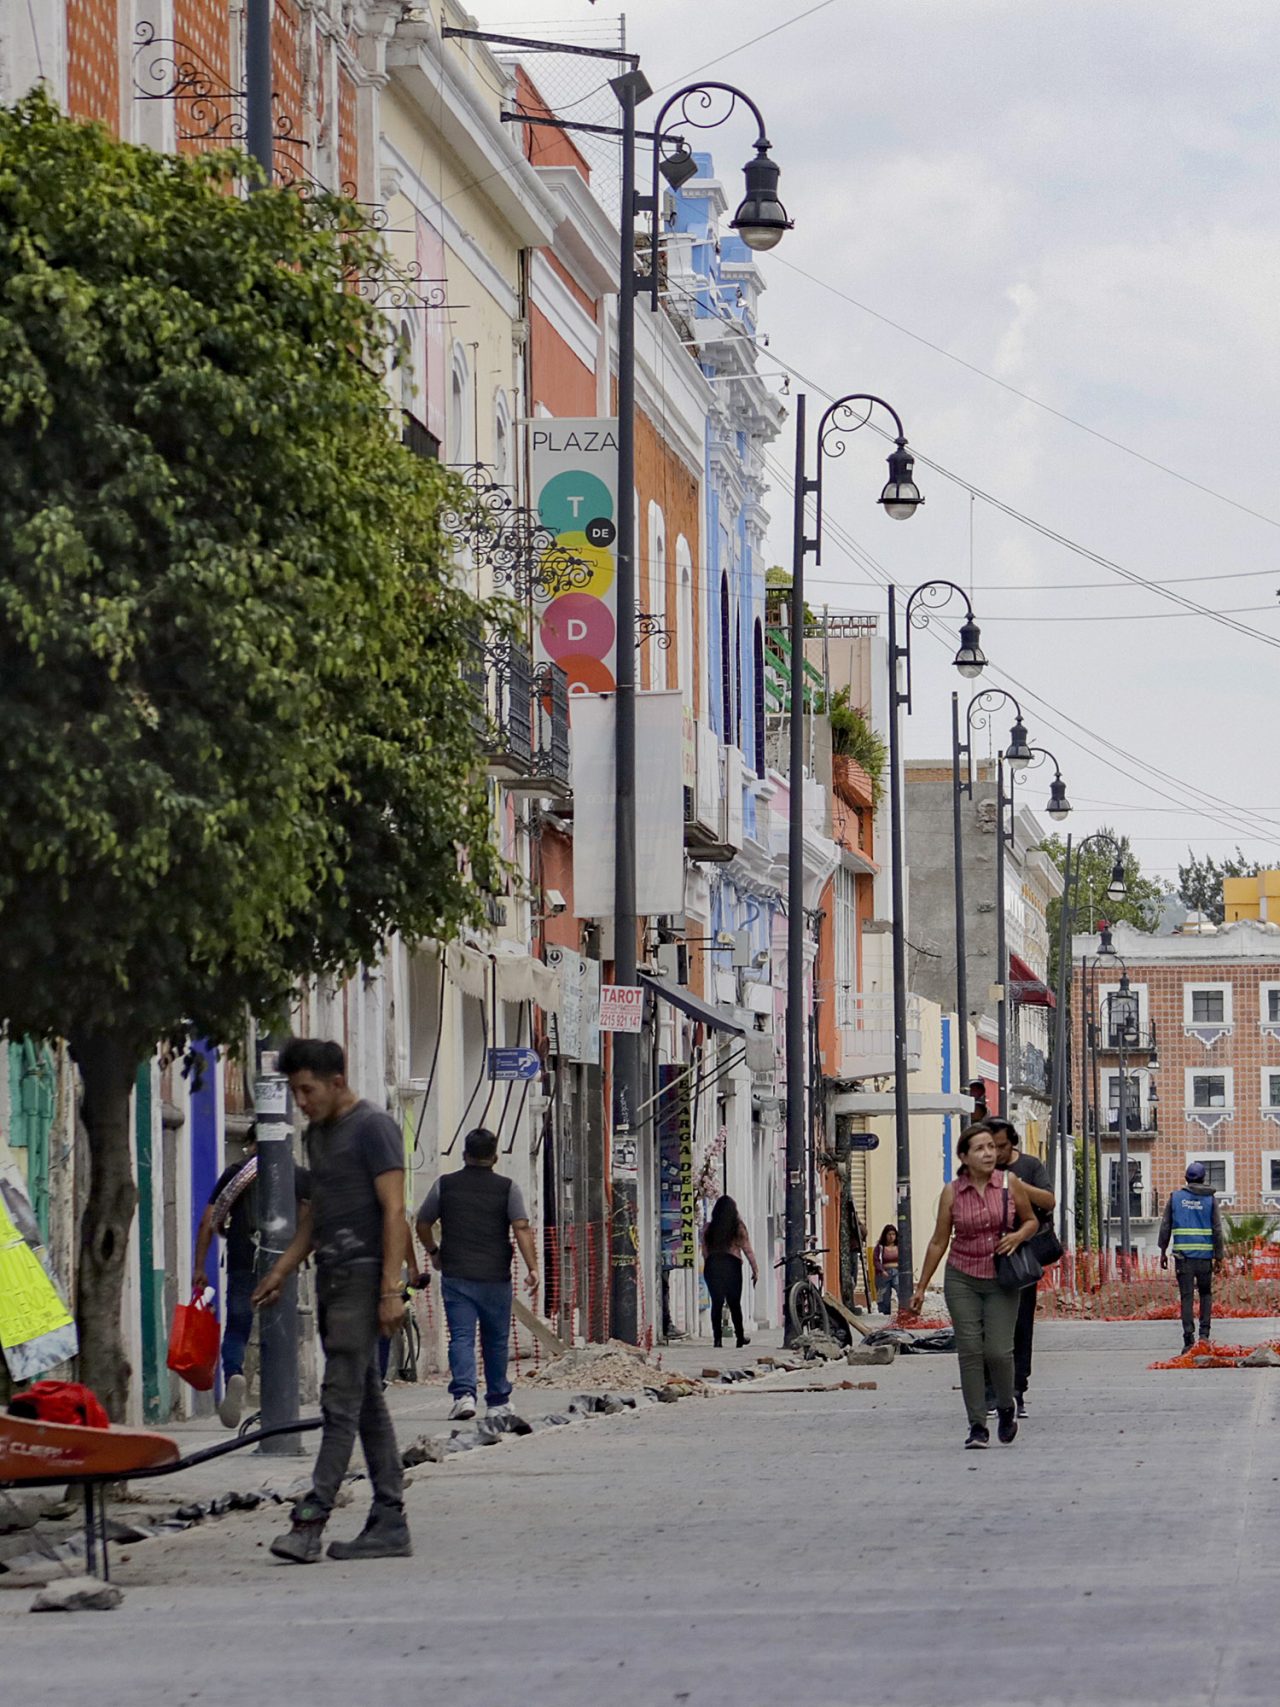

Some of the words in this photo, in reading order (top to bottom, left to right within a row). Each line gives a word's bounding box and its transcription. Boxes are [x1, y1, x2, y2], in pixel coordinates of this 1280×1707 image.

[533, 432, 618, 451] PLAZA
[592, 528, 609, 538] DE
[602, 988, 641, 1004] TAROT
[600, 1014, 616, 1026] 2215
[616, 1015, 627, 1027] 921
[680, 1162, 692, 1185] DE
